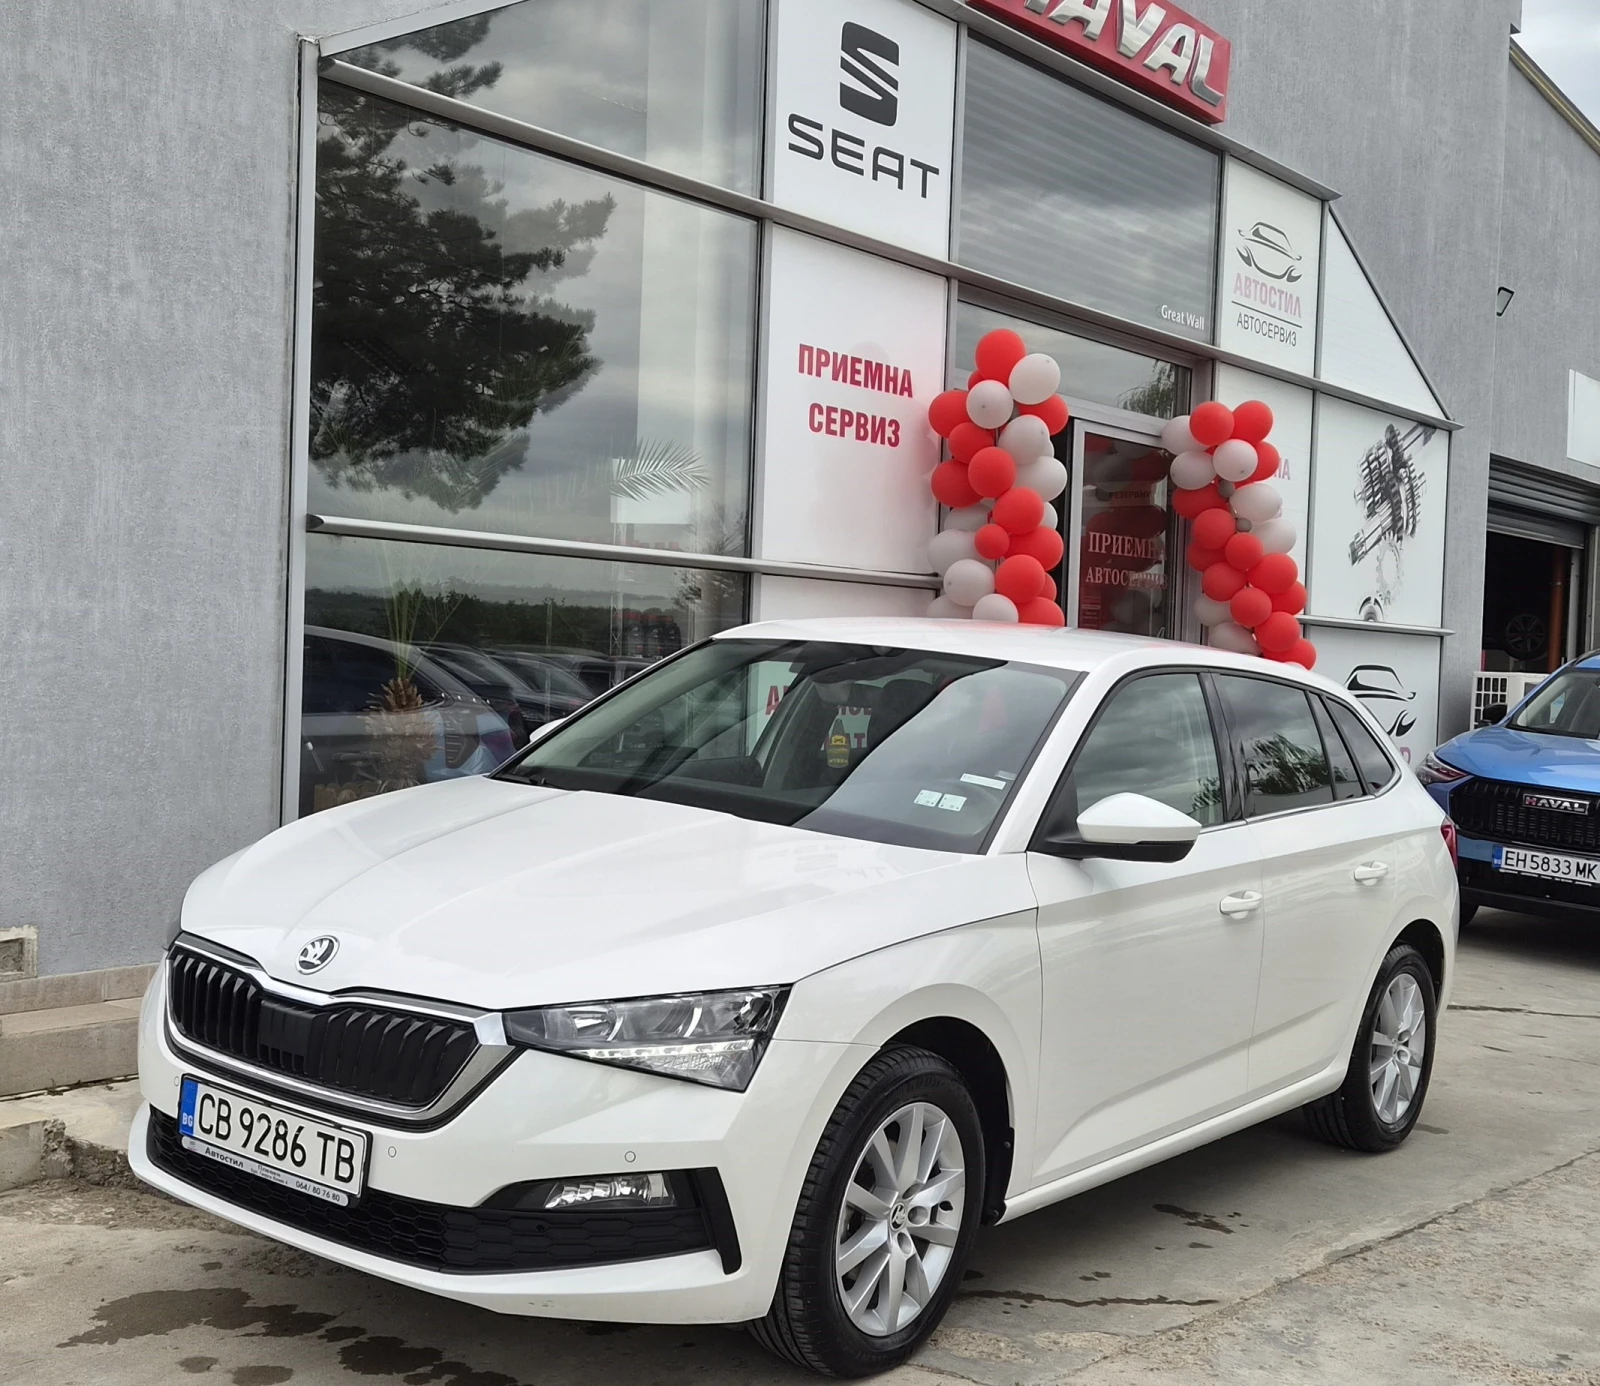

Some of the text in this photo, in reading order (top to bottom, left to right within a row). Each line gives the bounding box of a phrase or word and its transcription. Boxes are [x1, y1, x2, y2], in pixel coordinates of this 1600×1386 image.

[788, 113, 940, 199] SEAT
[1233, 272, 1302, 319] АВТОСТИЛ
[1161, 304, 1205, 331] Great Wall
[1236, 312, 1297, 347] АВТОСЕРВИЗ
[799, 343, 913, 399] ПРИЕМНА
[808, 402, 901, 448] СЕРВИЗ
[1525, 797, 1585, 812] HAVAL
[1504, 850, 1598, 881] EH 5833 MK
[182, 1112, 194, 1127] BG
[198, 1093, 355, 1184] CB 9286 TB
[204, 1146, 244, 1169] Автостил
[295, 1180, 341, 1203] 064/ 80 76 80
